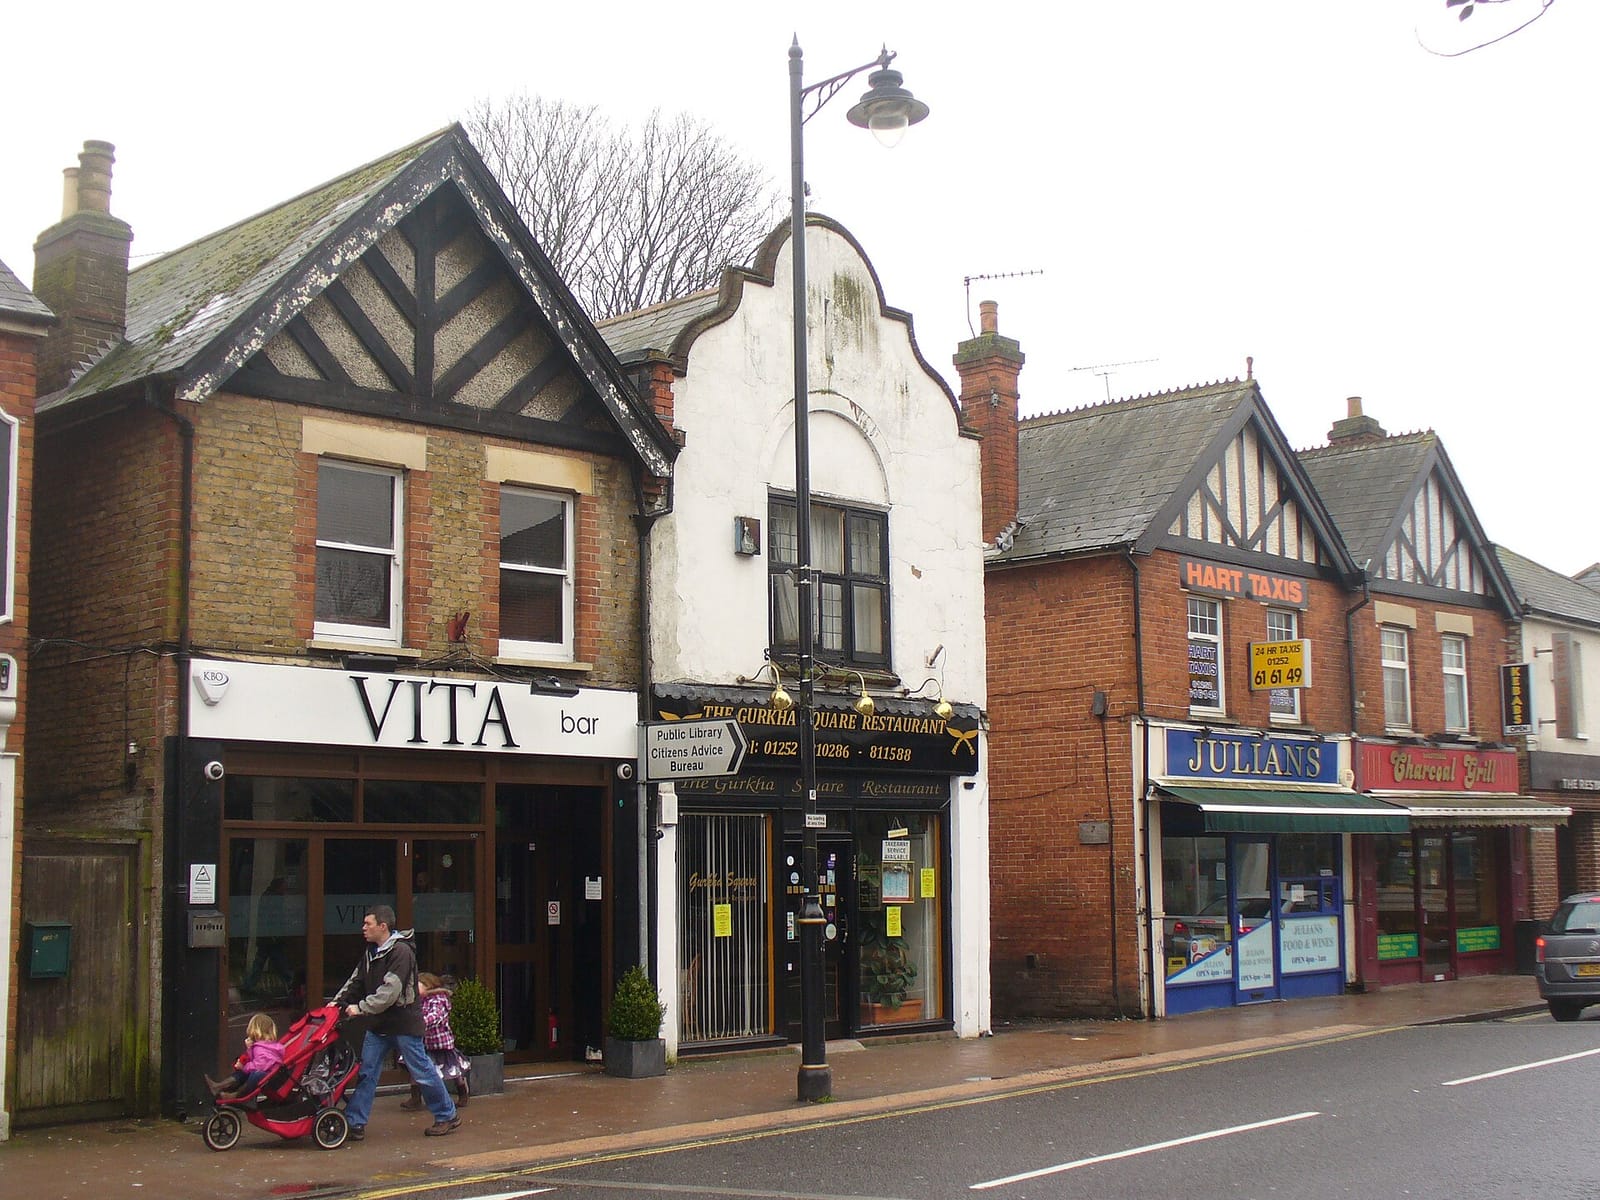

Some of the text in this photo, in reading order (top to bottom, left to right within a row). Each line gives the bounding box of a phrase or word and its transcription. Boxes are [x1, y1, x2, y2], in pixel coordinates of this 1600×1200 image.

[1187, 562, 1303, 603] HART TAXIS
[1255, 644, 1301, 656] 24 HR TAXIS
[1188, 661, 1217, 677] TAXIS
[1267, 657, 1289, 666] 01252
[203, 671, 224, 681] KBO
[1254, 668, 1303, 685] 61 61 49
[1511, 666, 1523, 724] KEBABS
[349, 675, 521, 748] VITA
[560, 709, 600, 735] bar
[703, 705, 947, 735] THE GURKHA QUARE RESTAURANT
[657, 727, 723, 741] Public Library
[651, 744, 724, 759] Citizens Advice
[764, 740, 798, 756] 01252
[814, 743, 850, 759] 10286
[869, 745, 912, 762] 811588
[1188, 738, 1321, 777] JULIANS
[670, 761, 704, 771] Bureau
[1390, 750, 1497, 789] Charcoal Grill
[714, 776, 776, 794] Gurkha
[791, 778, 845, 793] Suare
[861, 780, 942, 795] Restaurant
[1562, 779, 1577, 789] THE
[335, 904, 373, 925] VIT
[1294, 924, 1323, 936] JULIANS
[1283, 937, 1335, 952] FOOD & WINES
[1291, 956, 1305, 964] OPEN
[1196, 969, 1210, 977] OPEN
